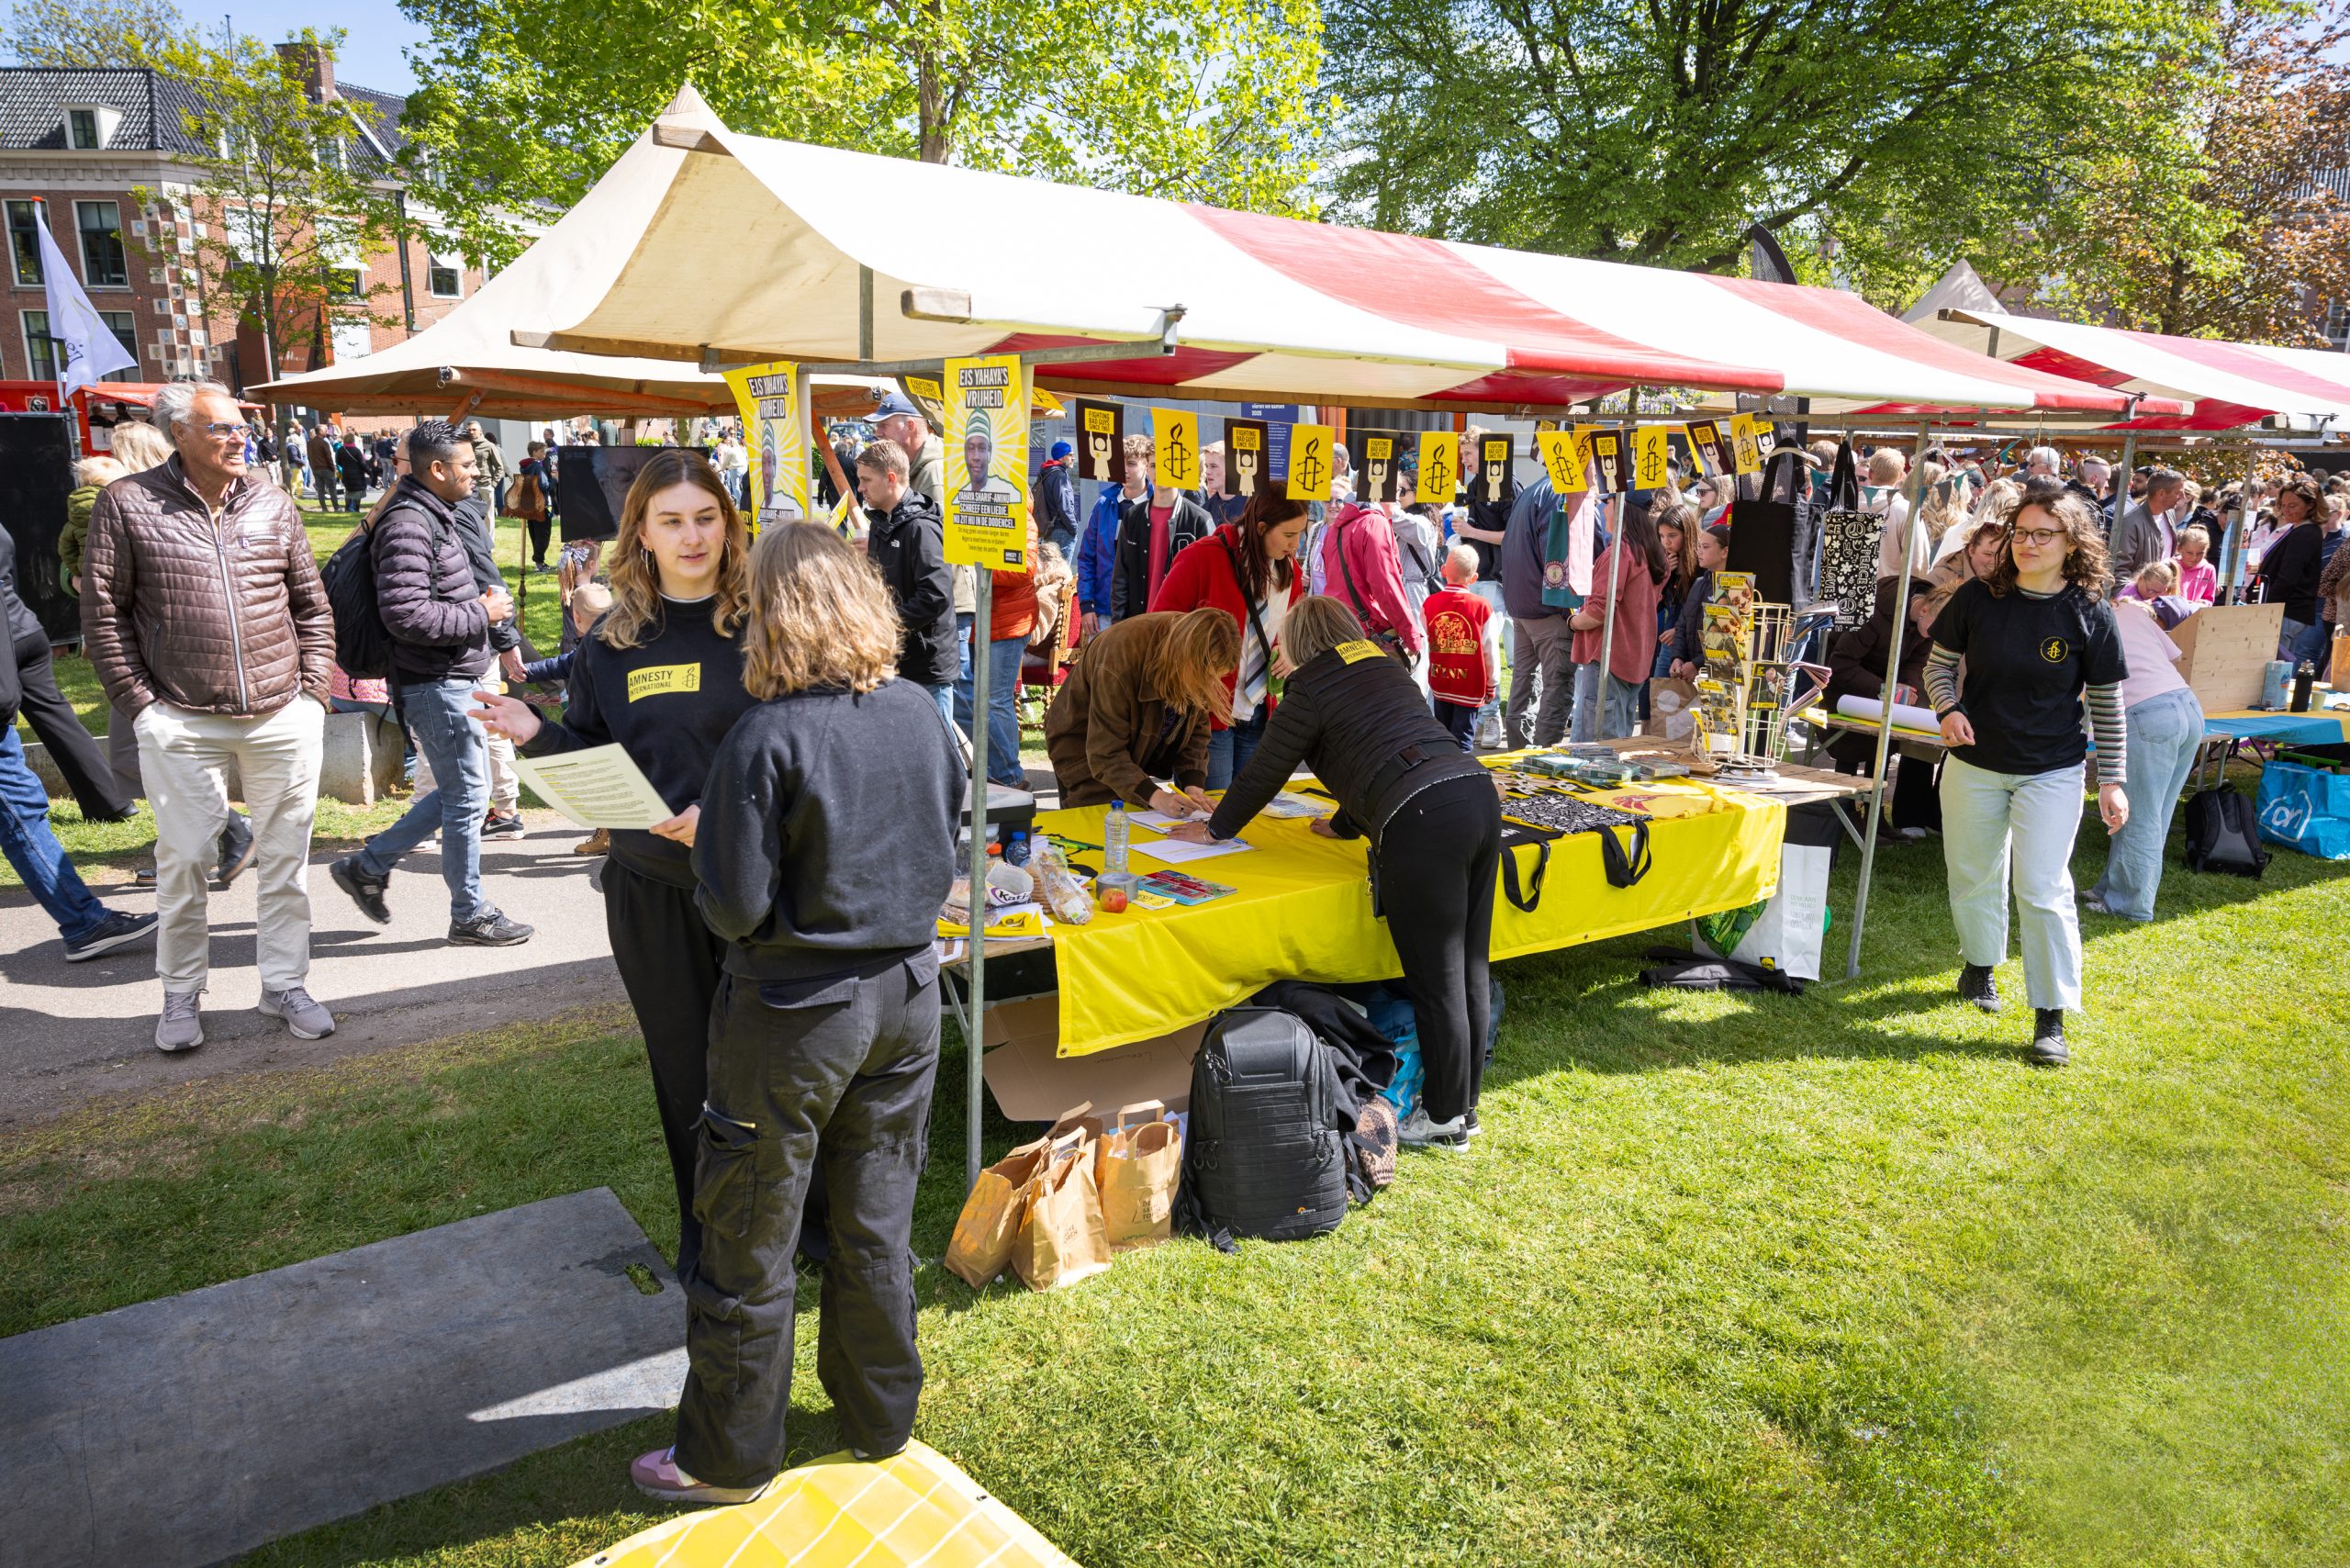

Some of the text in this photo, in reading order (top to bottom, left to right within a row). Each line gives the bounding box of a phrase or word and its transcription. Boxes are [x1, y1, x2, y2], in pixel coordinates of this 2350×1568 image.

[959, 367, 1008, 386] EIS YAHAYA'S
[748, 377, 764, 397] EIS
[1089, 410, 1110, 420] FIGHTING
[959, 503, 980, 513] SCHREEF
[981, 504, 990, 514] EEN
[953, 514, 959, 524] NU
[976, 516, 981, 525] IN
[981, 517, 989, 526] DE
[1857, 549, 1872, 585] PEACE
[1824, 566, 1838, 593] LOVE
[1338, 641, 1369, 655] AMNESTY
[629, 670, 673, 689] AMNESTY
[630, 681, 672, 696] INTERNATIONAL
